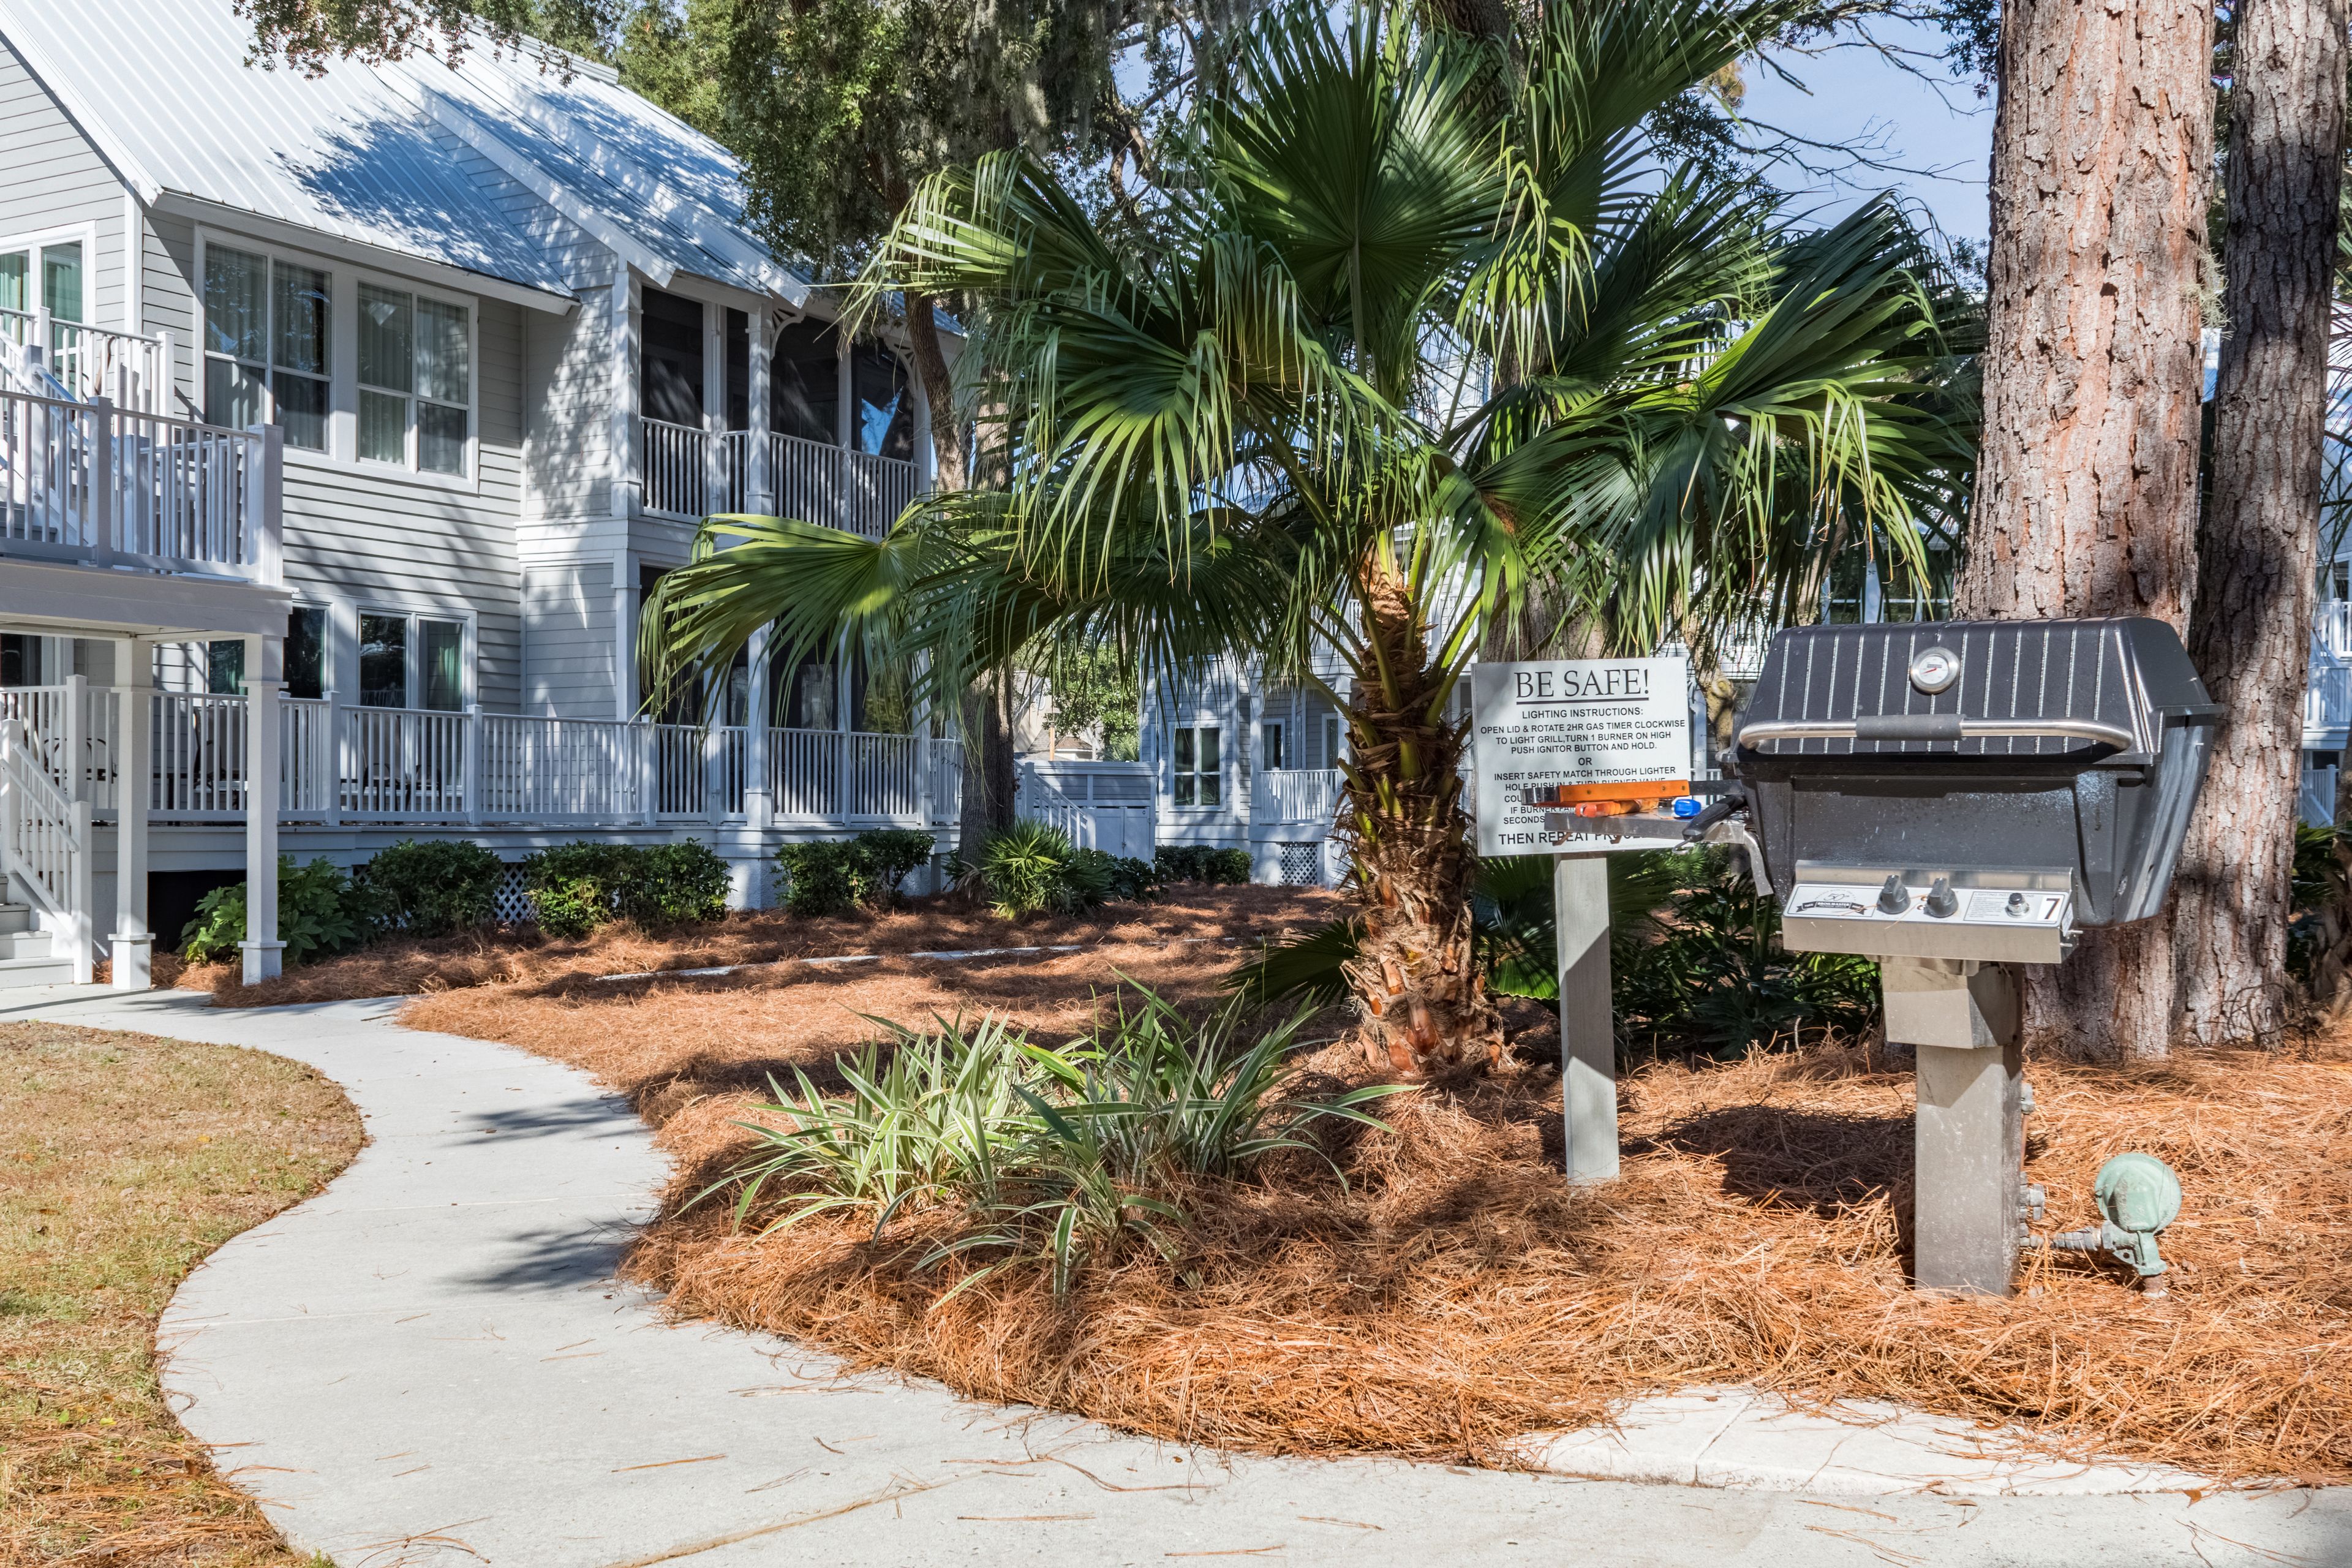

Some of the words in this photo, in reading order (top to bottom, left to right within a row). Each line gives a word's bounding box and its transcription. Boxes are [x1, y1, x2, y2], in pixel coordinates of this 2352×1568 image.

[1514, 671, 1555, 698] BE
[1564, 669, 1649, 697] SAFE!
[1522, 709, 1567, 719] LIGHTING
[1570, 707, 1643, 717] INSTRUCTIONS:
[1635, 720, 1686, 728] CLOCKWISE
[1537, 745, 1572, 753] IGNITOR
[1578, 757, 1593, 766] OR
[1563, 770, 1593, 778] MATCH
[1595, 768, 1637, 777] THROUGH
[1640, 766, 1676, 775] LIGHTER
[1504, 816, 1545, 824] SECONDS
[1499, 833, 1534, 845] THEN
[2044, 898, 2060, 919] 7
